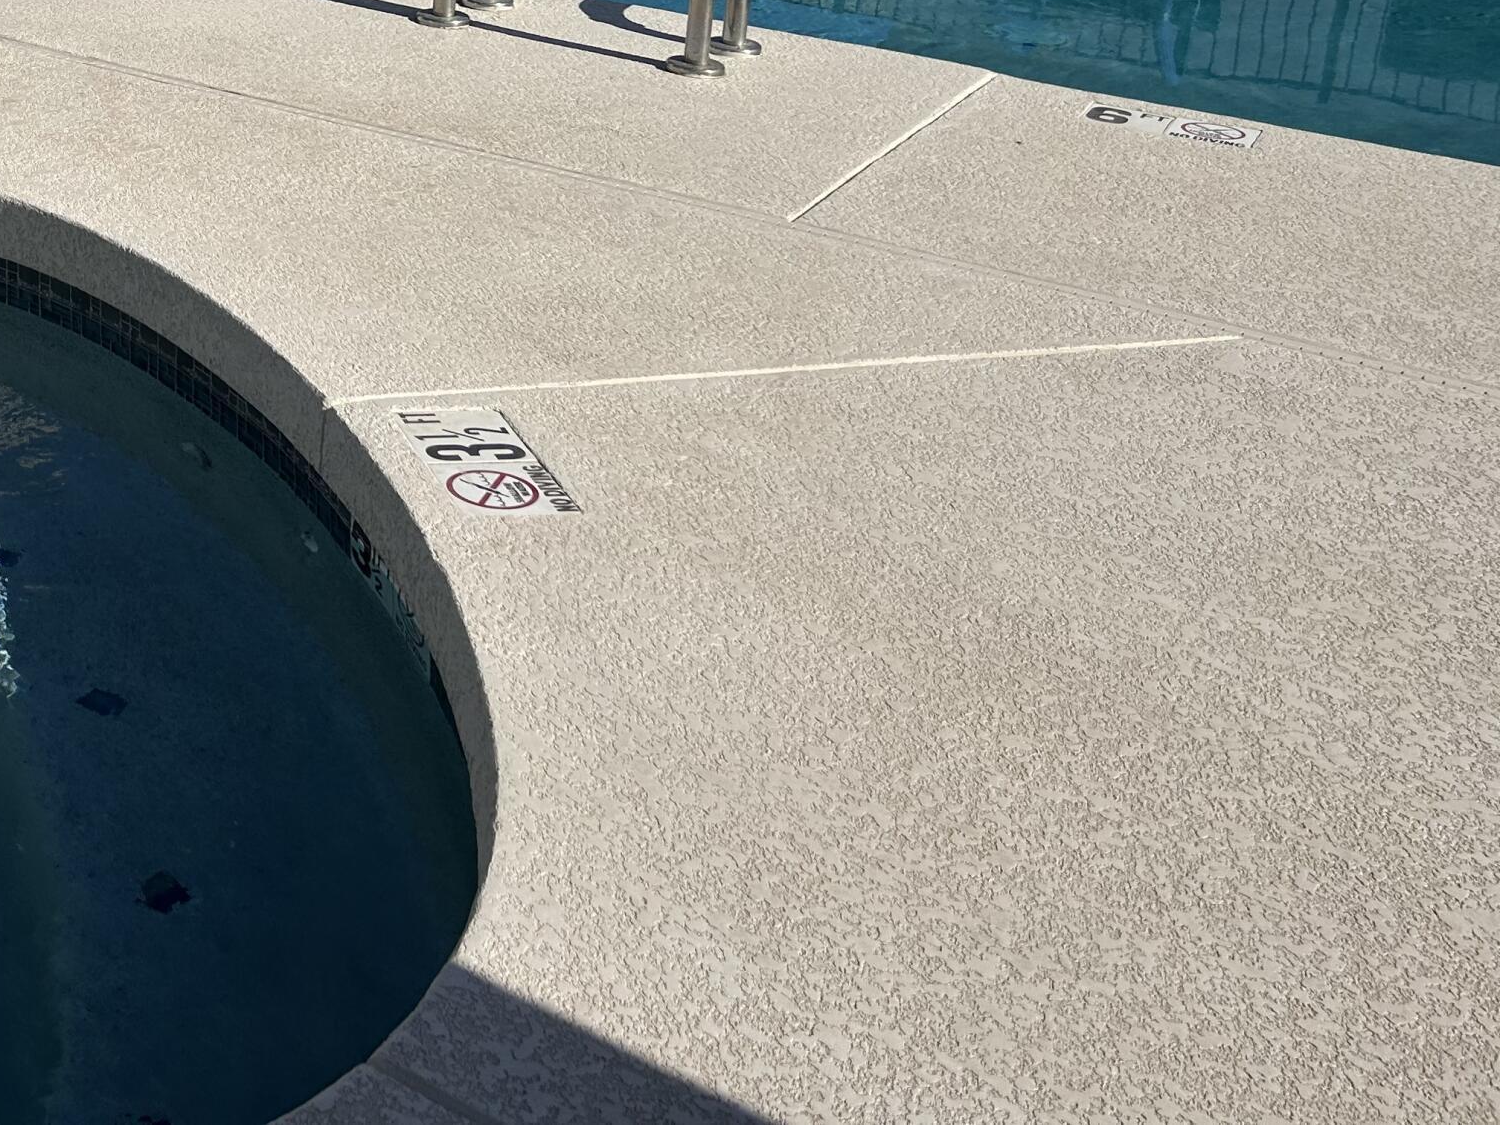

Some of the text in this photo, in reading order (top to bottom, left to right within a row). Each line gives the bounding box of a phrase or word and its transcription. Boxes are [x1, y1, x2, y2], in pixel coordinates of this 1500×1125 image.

[1086, 106, 1170, 124] 6 FT
[1193, 136, 1246, 148] DIVING
[398, 412, 442, 425] FT
[425, 443, 527, 462] 3
[522, 465, 580, 512] NO DIVING
